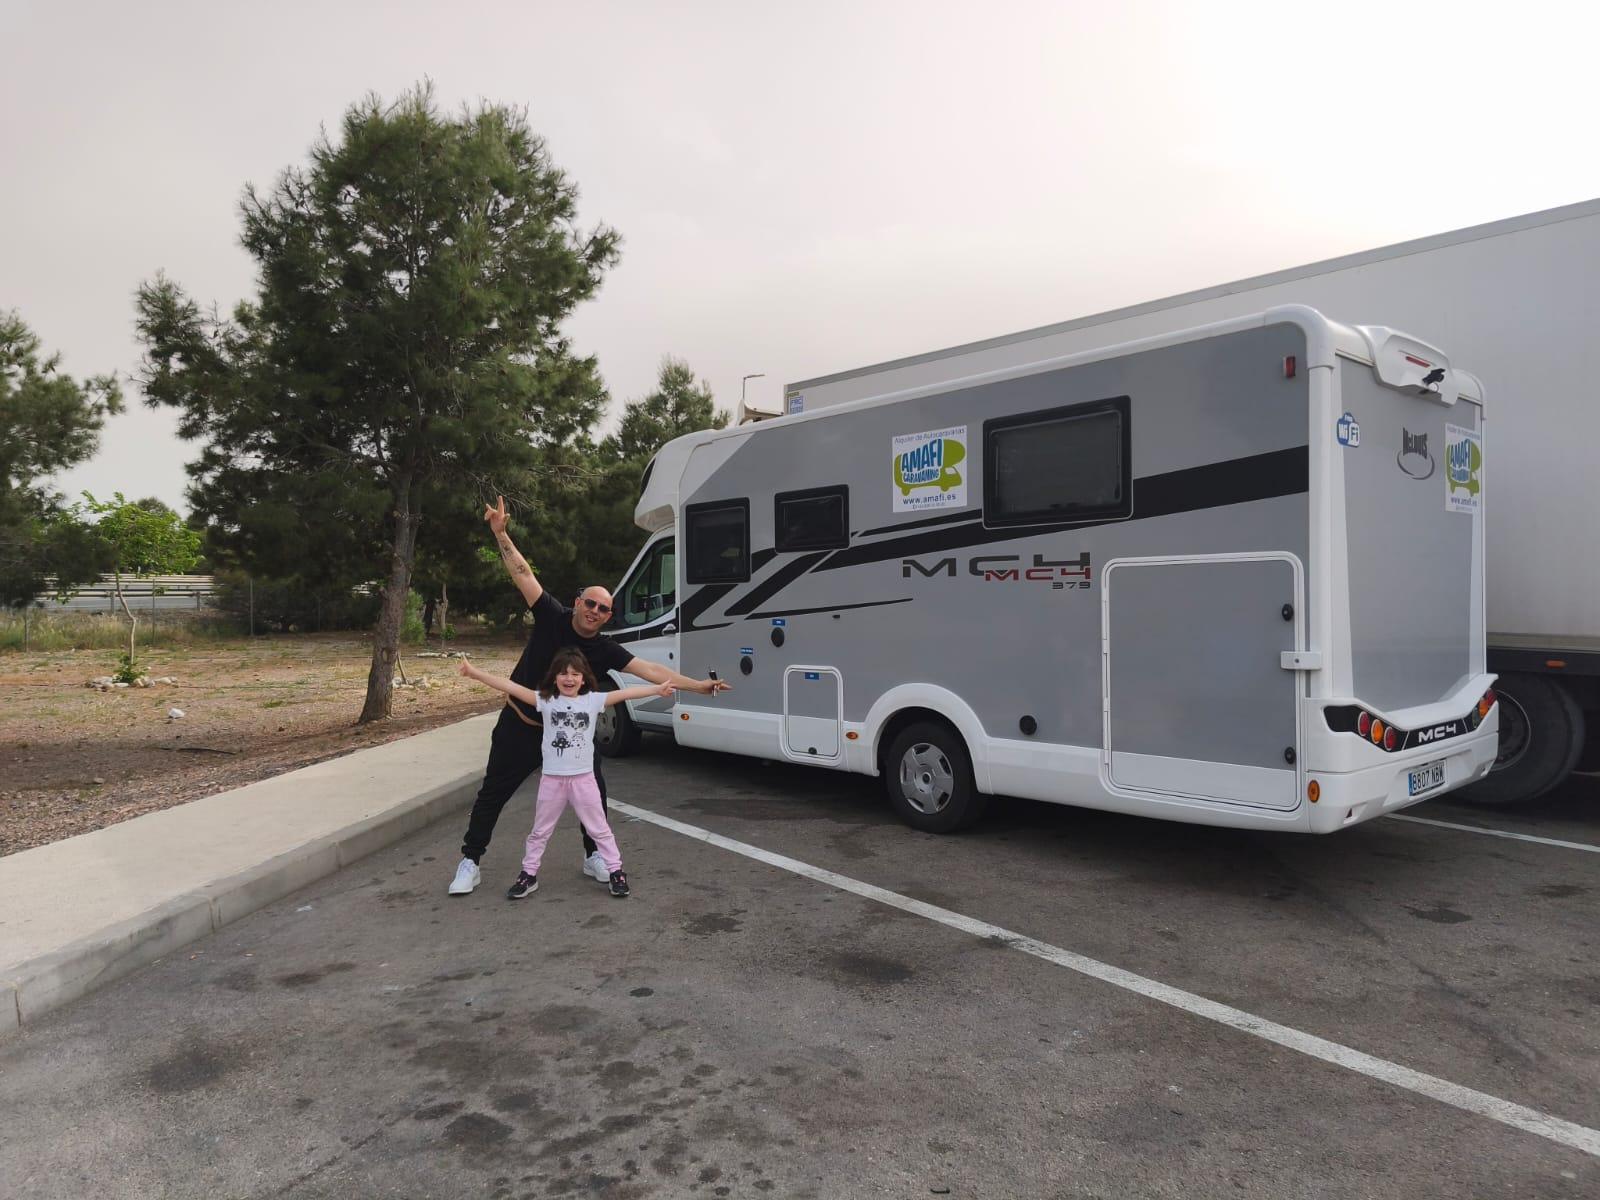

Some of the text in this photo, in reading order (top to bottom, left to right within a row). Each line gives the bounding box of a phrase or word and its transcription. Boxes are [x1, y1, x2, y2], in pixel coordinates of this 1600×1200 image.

[902, 439, 942, 472] AMAFI
[1450, 439, 1471, 469] AMAFI
[903, 493, 956, 505] www.amafi.es
[903, 552, 1091, 577] MC4
[985, 567, 1091, 581] MC4
[1052, 581, 1091, 589] 379
[1418, 723, 1457, 743] MC4
